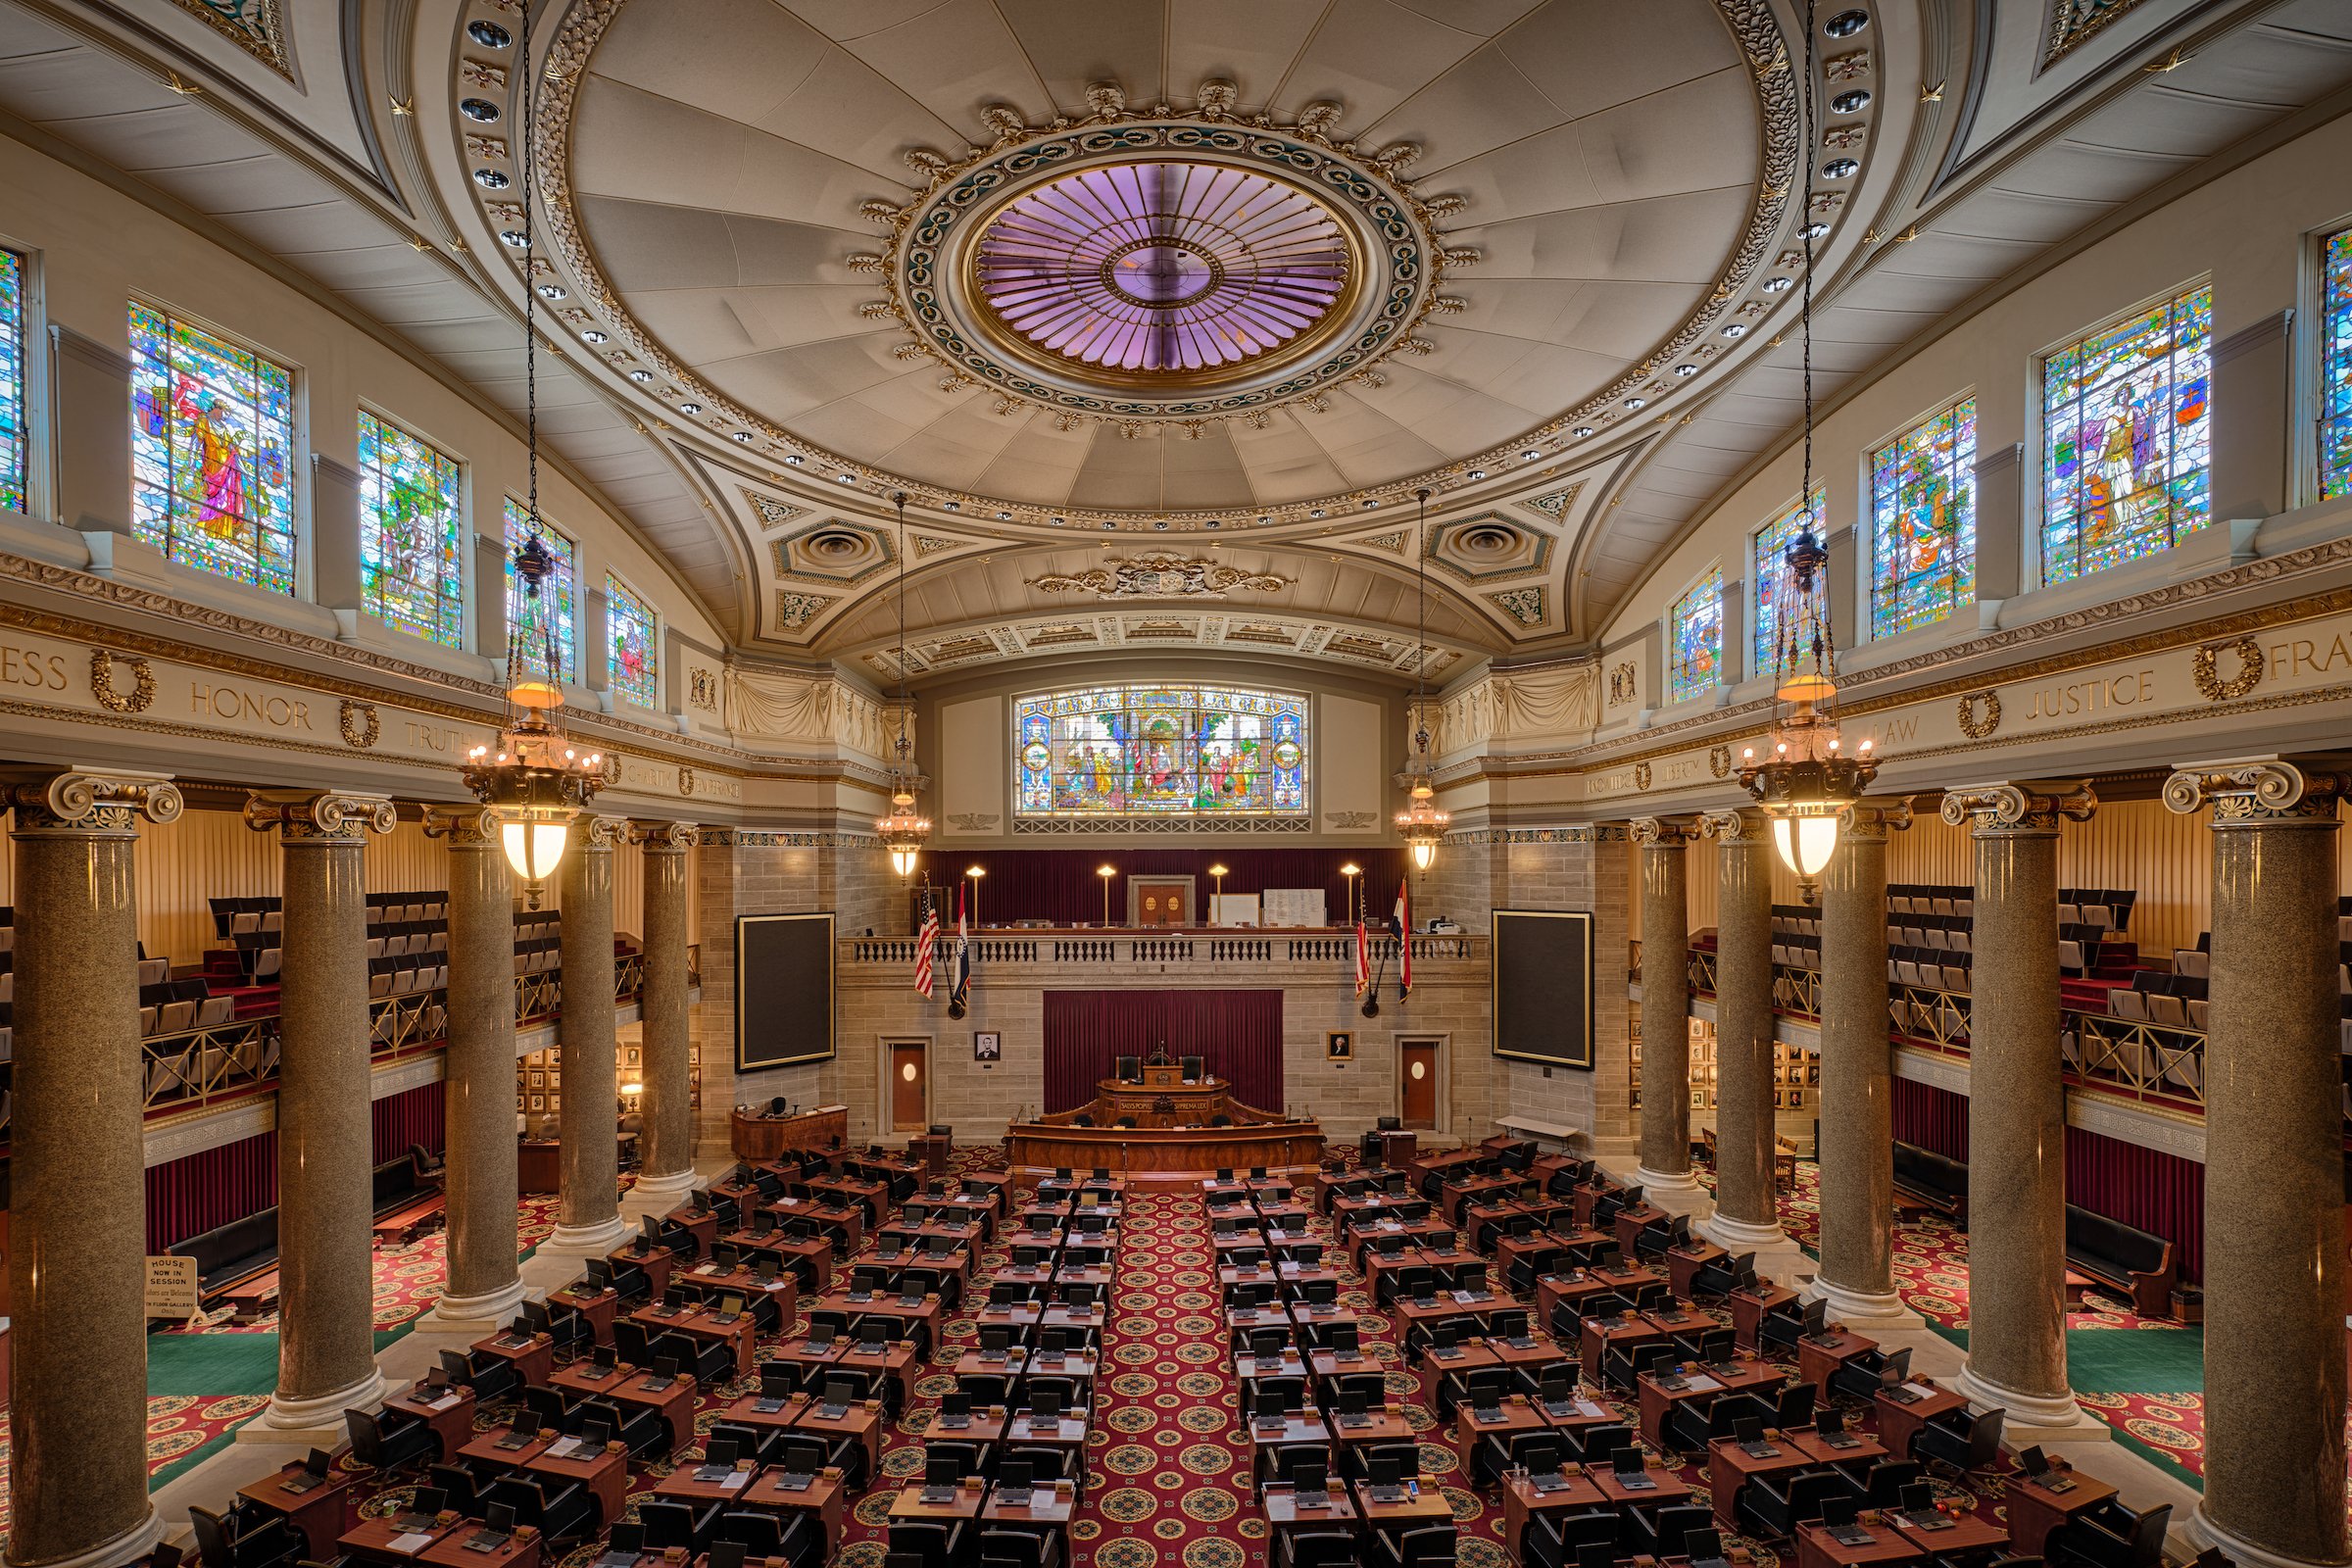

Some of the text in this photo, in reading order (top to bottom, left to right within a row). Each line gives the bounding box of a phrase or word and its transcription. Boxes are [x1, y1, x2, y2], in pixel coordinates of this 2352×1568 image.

[2269, 631, 2352, 681] FRA
[190, 681, 314, 731] HONOR
[2025, 669, 2154, 720] JUSTICE
[404, 721, 472, 755] TRUTH
[1873, 714, 1920, 747] LAW
[627, 764, 671, 788] CHARITY
[1661, 760, 1700, 782] LIBERTY
[152, 1259, 185, 1269] HOUSE
